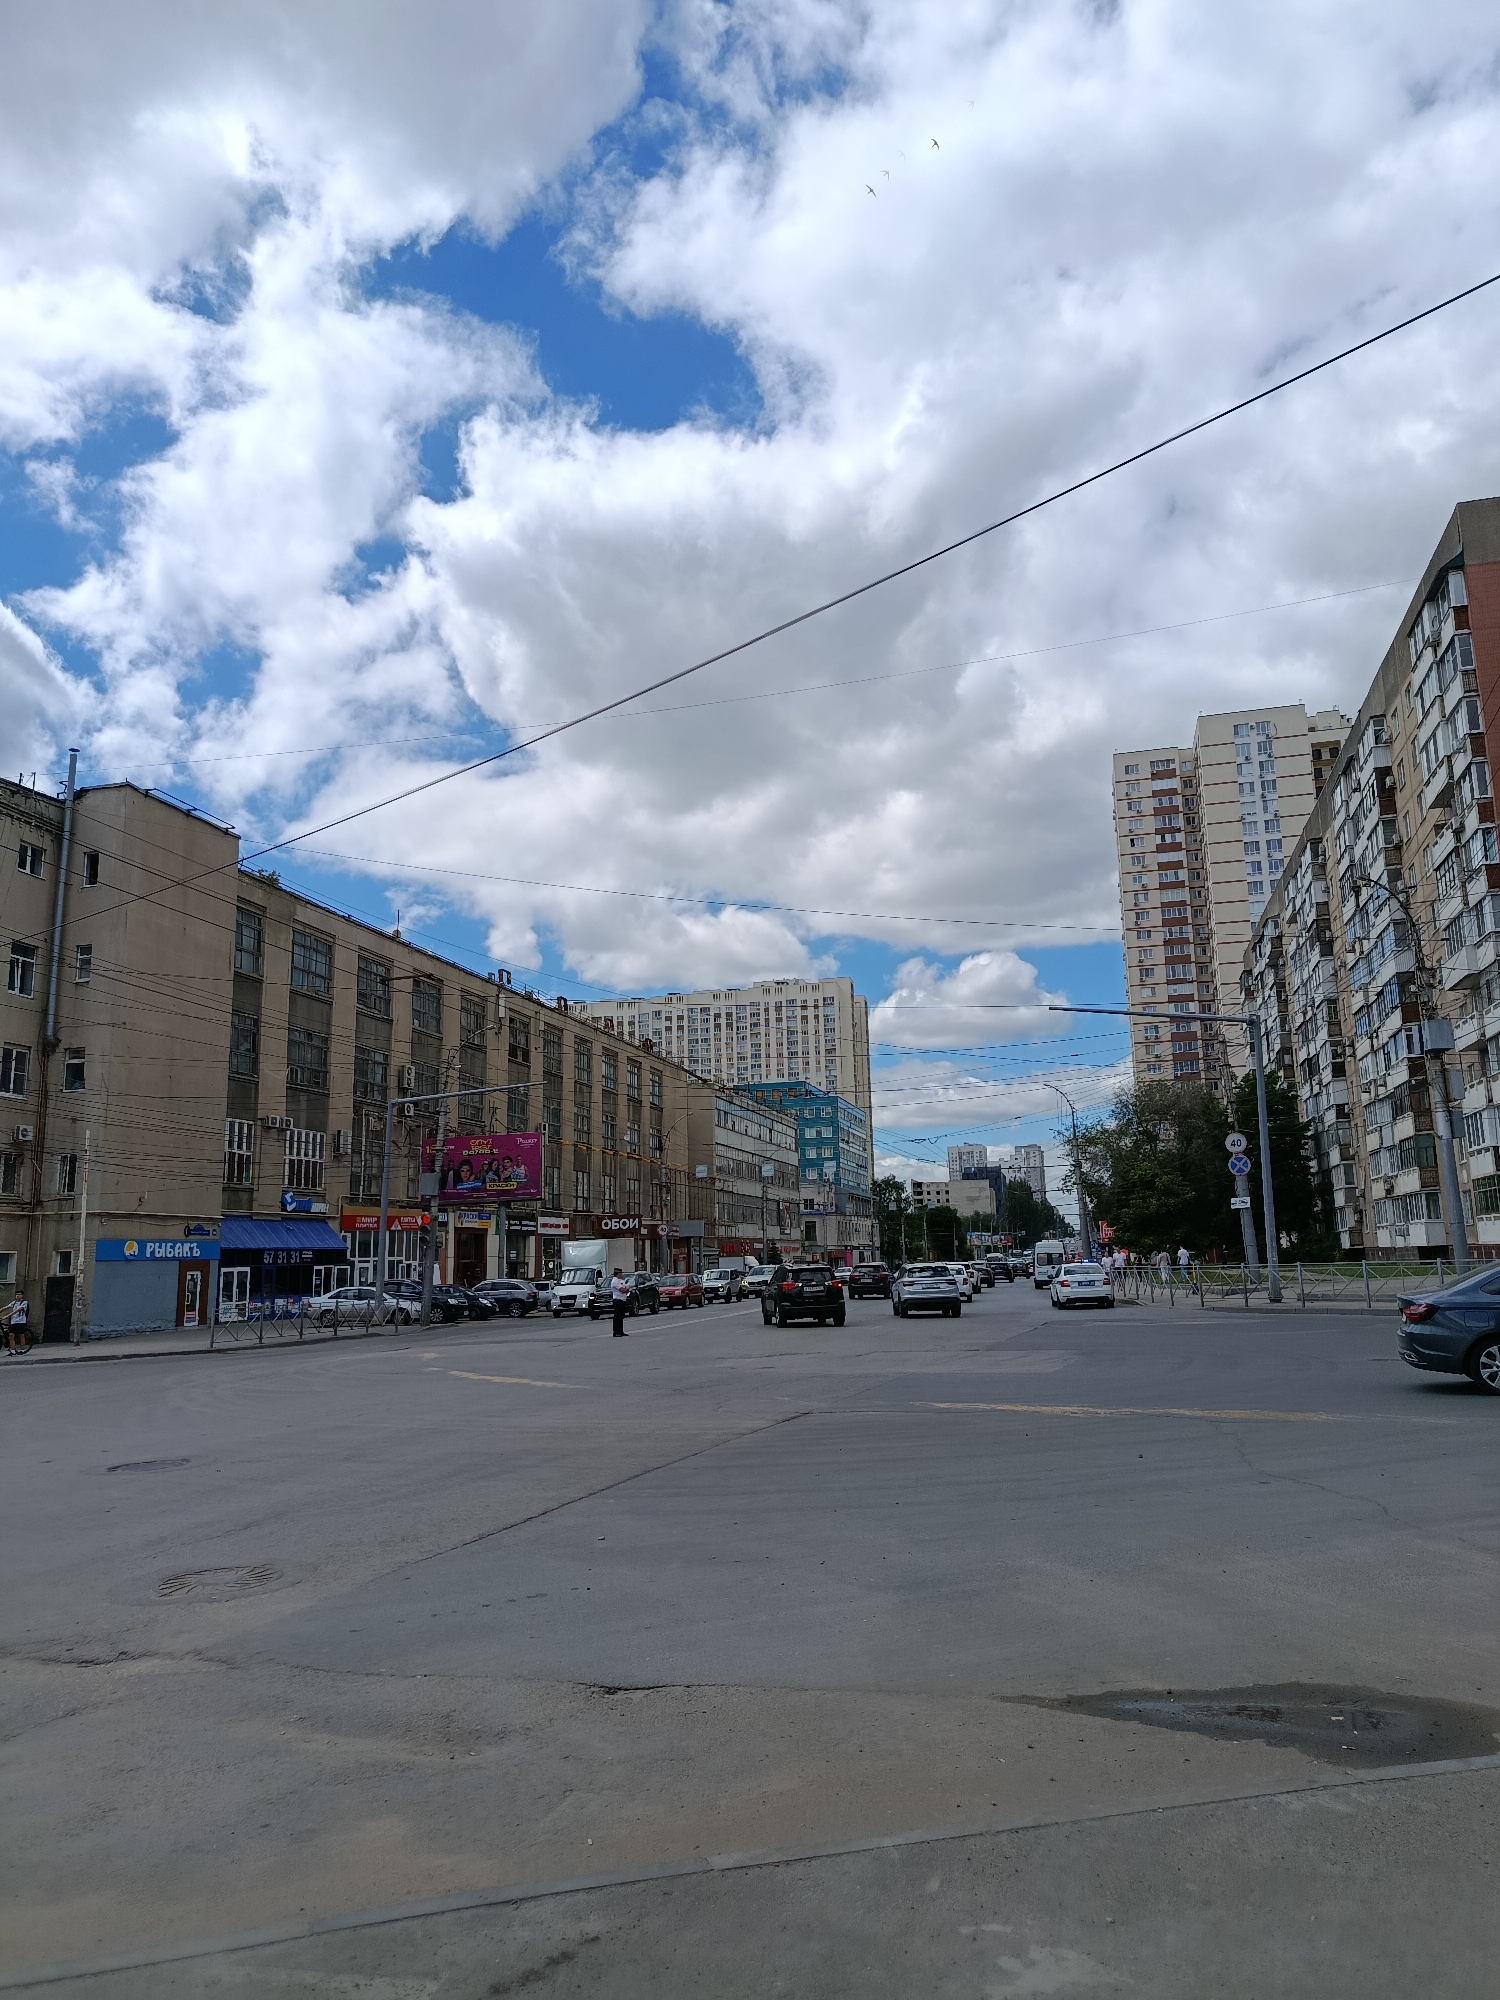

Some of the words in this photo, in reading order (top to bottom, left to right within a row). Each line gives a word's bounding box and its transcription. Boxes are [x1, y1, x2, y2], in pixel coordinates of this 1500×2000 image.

[1230, 1138, 1242, 1148] 40
[361, 1216, 378, 1224] МИР
[601, 1217, 639, 1230] ОБОИ
[145, 1242, 201, 1258] РЫБАКЪ
[263, 1250, 275, 1264] 57
[277, 1250, 287, 1264] 31
[290, 1250, 300, 1264] 31
